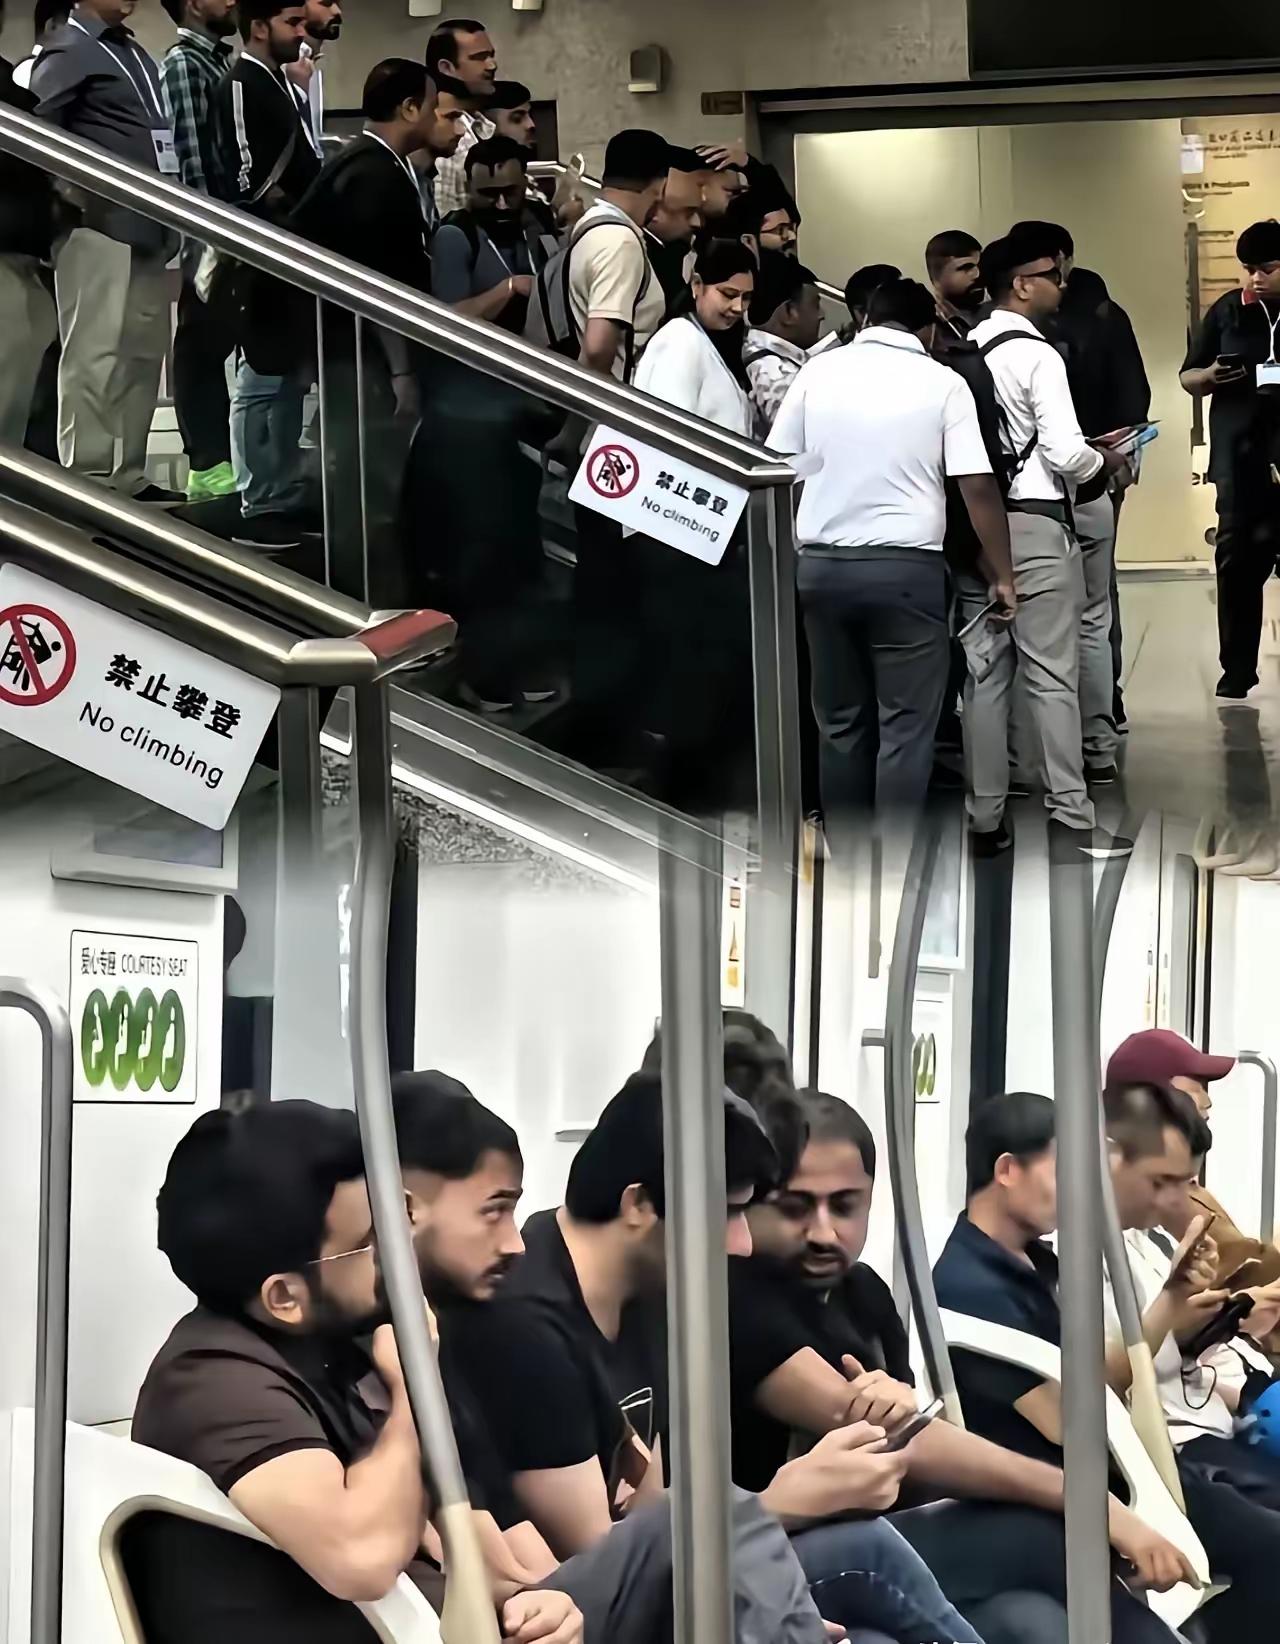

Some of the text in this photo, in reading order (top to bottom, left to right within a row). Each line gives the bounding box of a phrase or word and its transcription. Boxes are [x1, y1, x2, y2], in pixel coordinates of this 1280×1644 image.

[641, 496, 720, 542] No climbing
[105, 654, 241, 739] 禁止攀登
[79, 701, 224, 789] No climbing
[121, 954, 166, 976] COURTESY
[169, 958, 188, 976] SEAT
